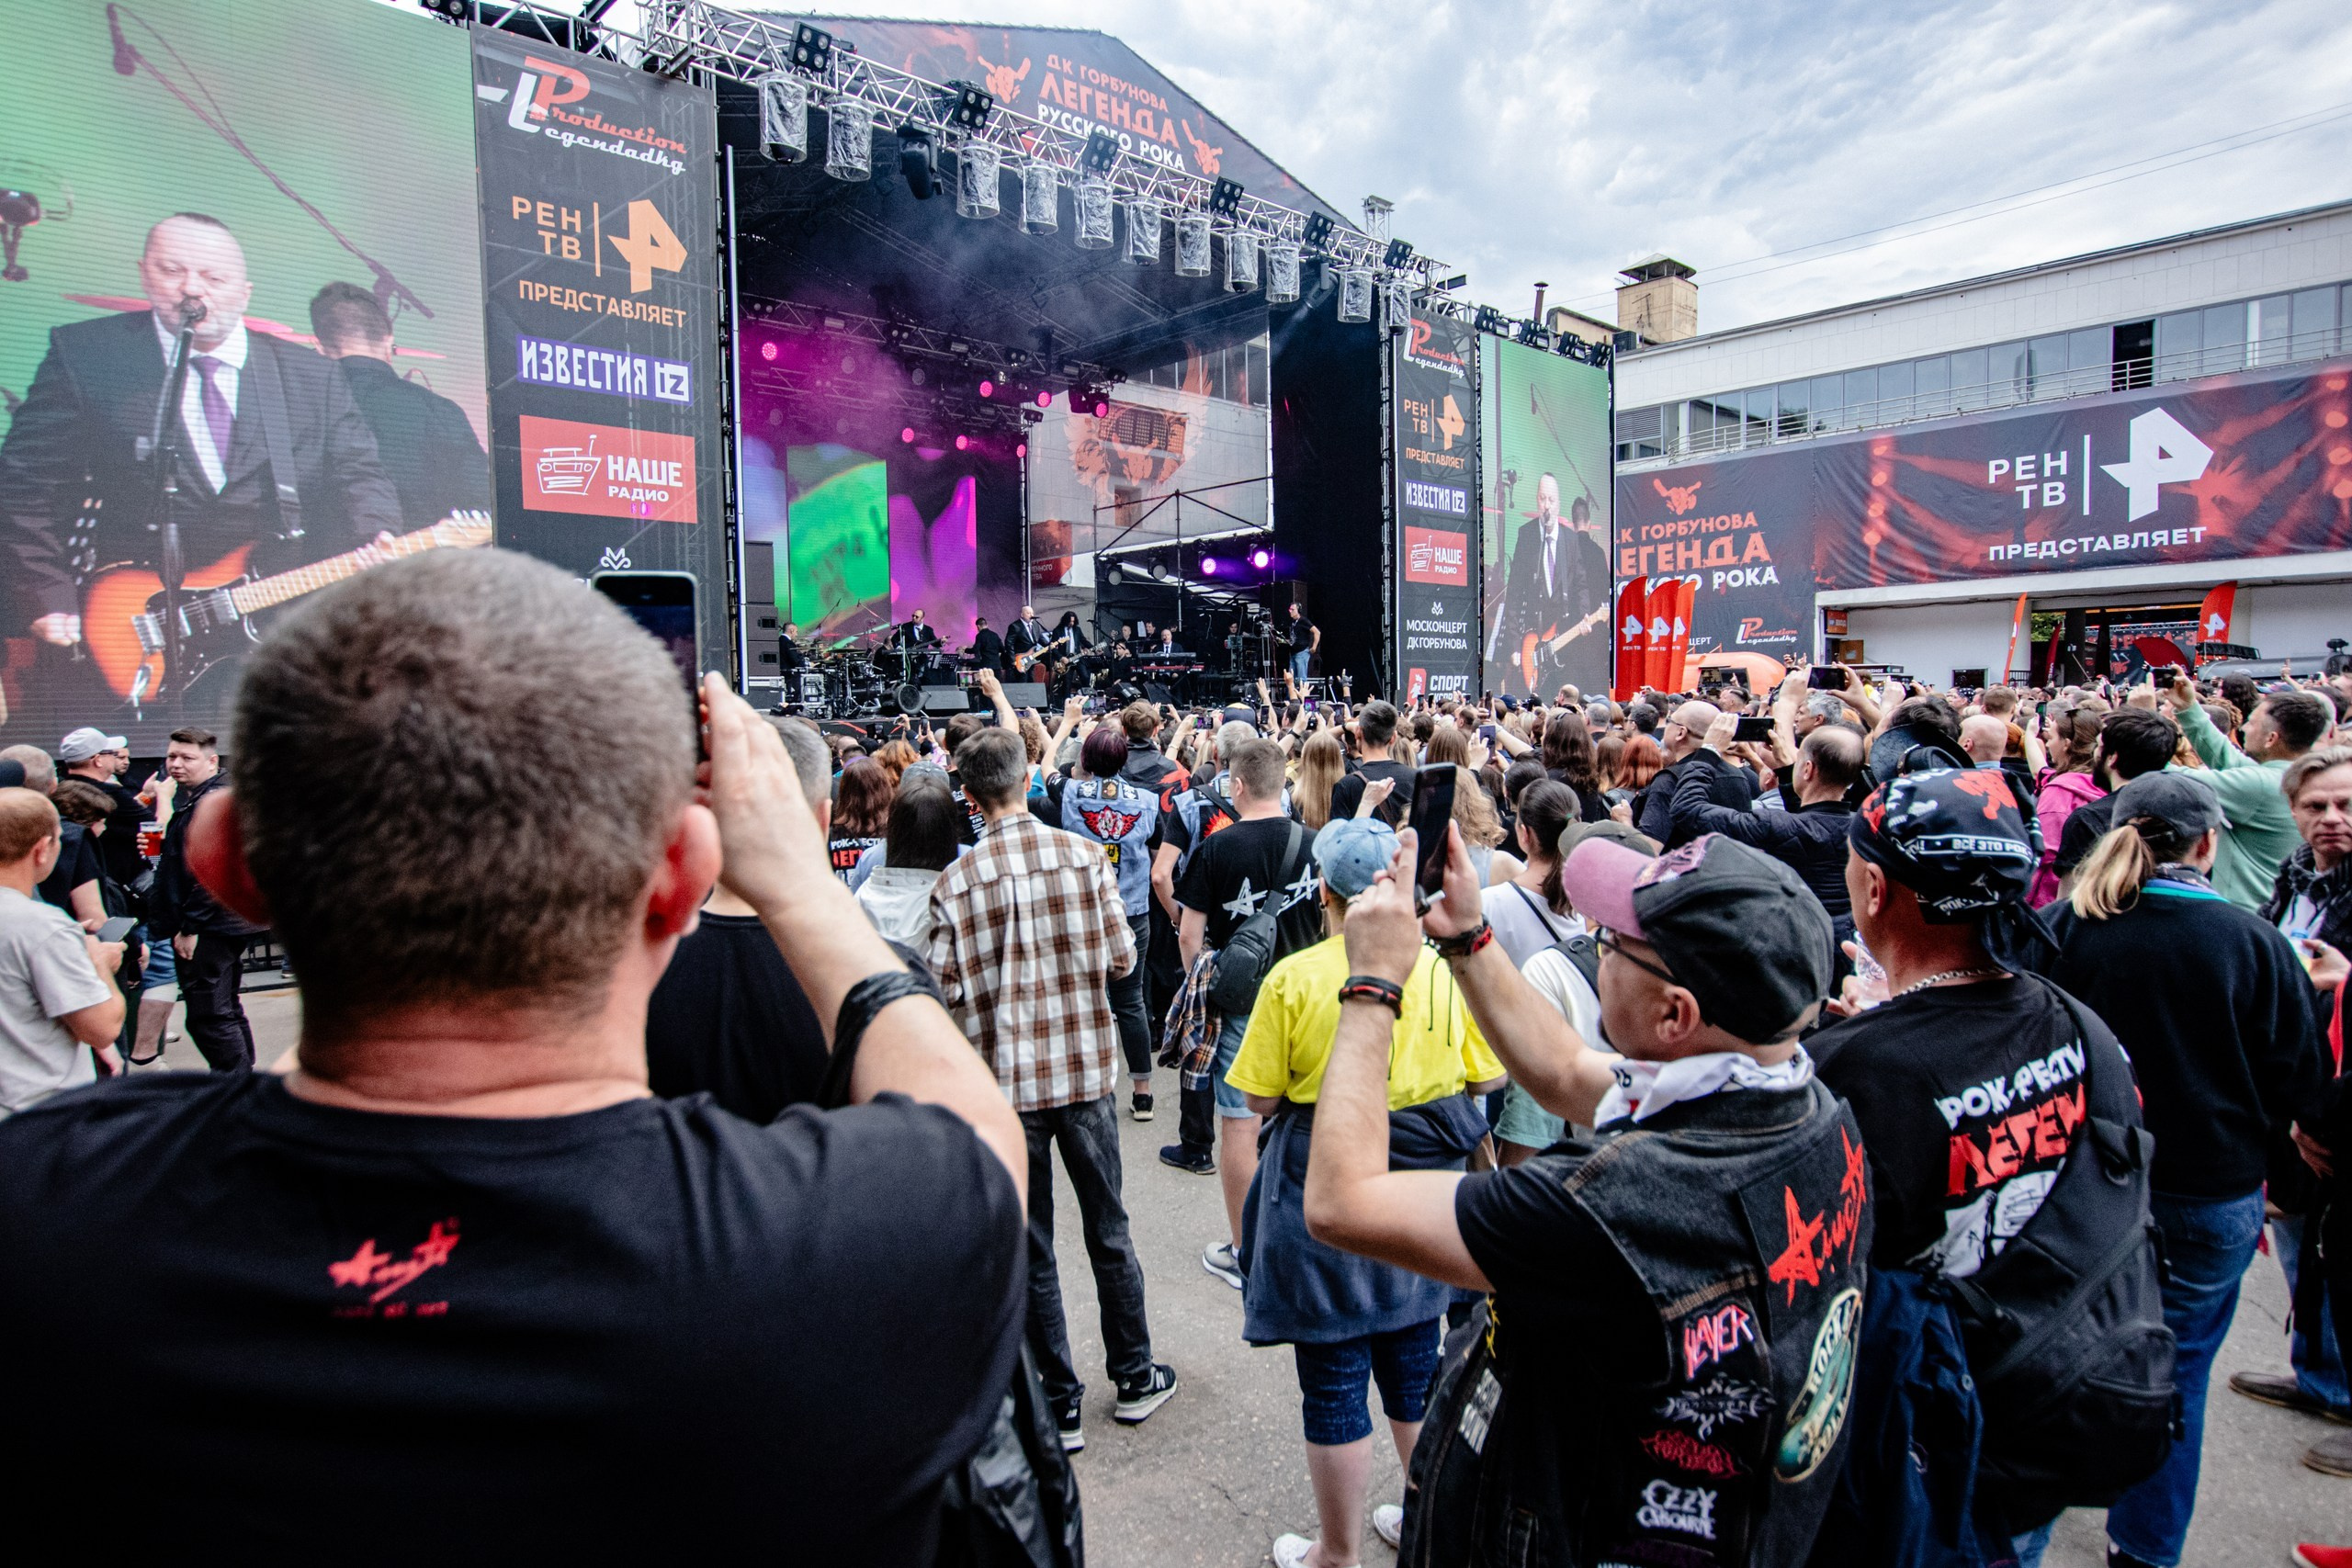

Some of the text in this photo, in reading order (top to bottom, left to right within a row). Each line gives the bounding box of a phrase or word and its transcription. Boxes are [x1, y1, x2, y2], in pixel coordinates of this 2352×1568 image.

[1046, 54, 1169, 112] ДК ГОРБУНОВА
[523, 55, 687, 155] Production
[1038, 71, 1182, 150] ЛЕГЕНДА
[1139, 138, 1186, 172] РОКА
[512, 196, 582, 233] РЕН
[537, 229, 582, 261] ТВ
[518, 278, 687, 329] ПРЕДСТАВЛЯЕТ
[1408, 317, 1465, 366] Production
[521, 338, 648, 396] ИЗВЕСТИЯ
[1404, 399, 1429, 418] РЕН
[1412, 417, 1429, 434] ТВ
[606, 454, 684, 488] НАШЕ
[1406, 446, 1465, 469] ПРЕДСТАВЛЯЕТ
[1988, 450, 2068, 485] РЕН
[607, 485, 670, 502] РАДИО
[1406, 481, 1451, 513] ИЗВЕСТИЯ
[2015, 480, 2067, 510] ТВ
[1616, 511, 1759, 544] К ГОРБУНОВА
[1988, 525, 2208, 561] ПРЕДСТАВЛЯЕТ
[1434, 547, 1463, 566] НАШЕ
[1434, 565, 1458, 575] РАДИО
[1713, 565, 1781, 592] РОКА
[1406, 619, 1467, 635] МОСКОНЦЕРТ
[1430, 675, 1469, 691] СПОРТ
